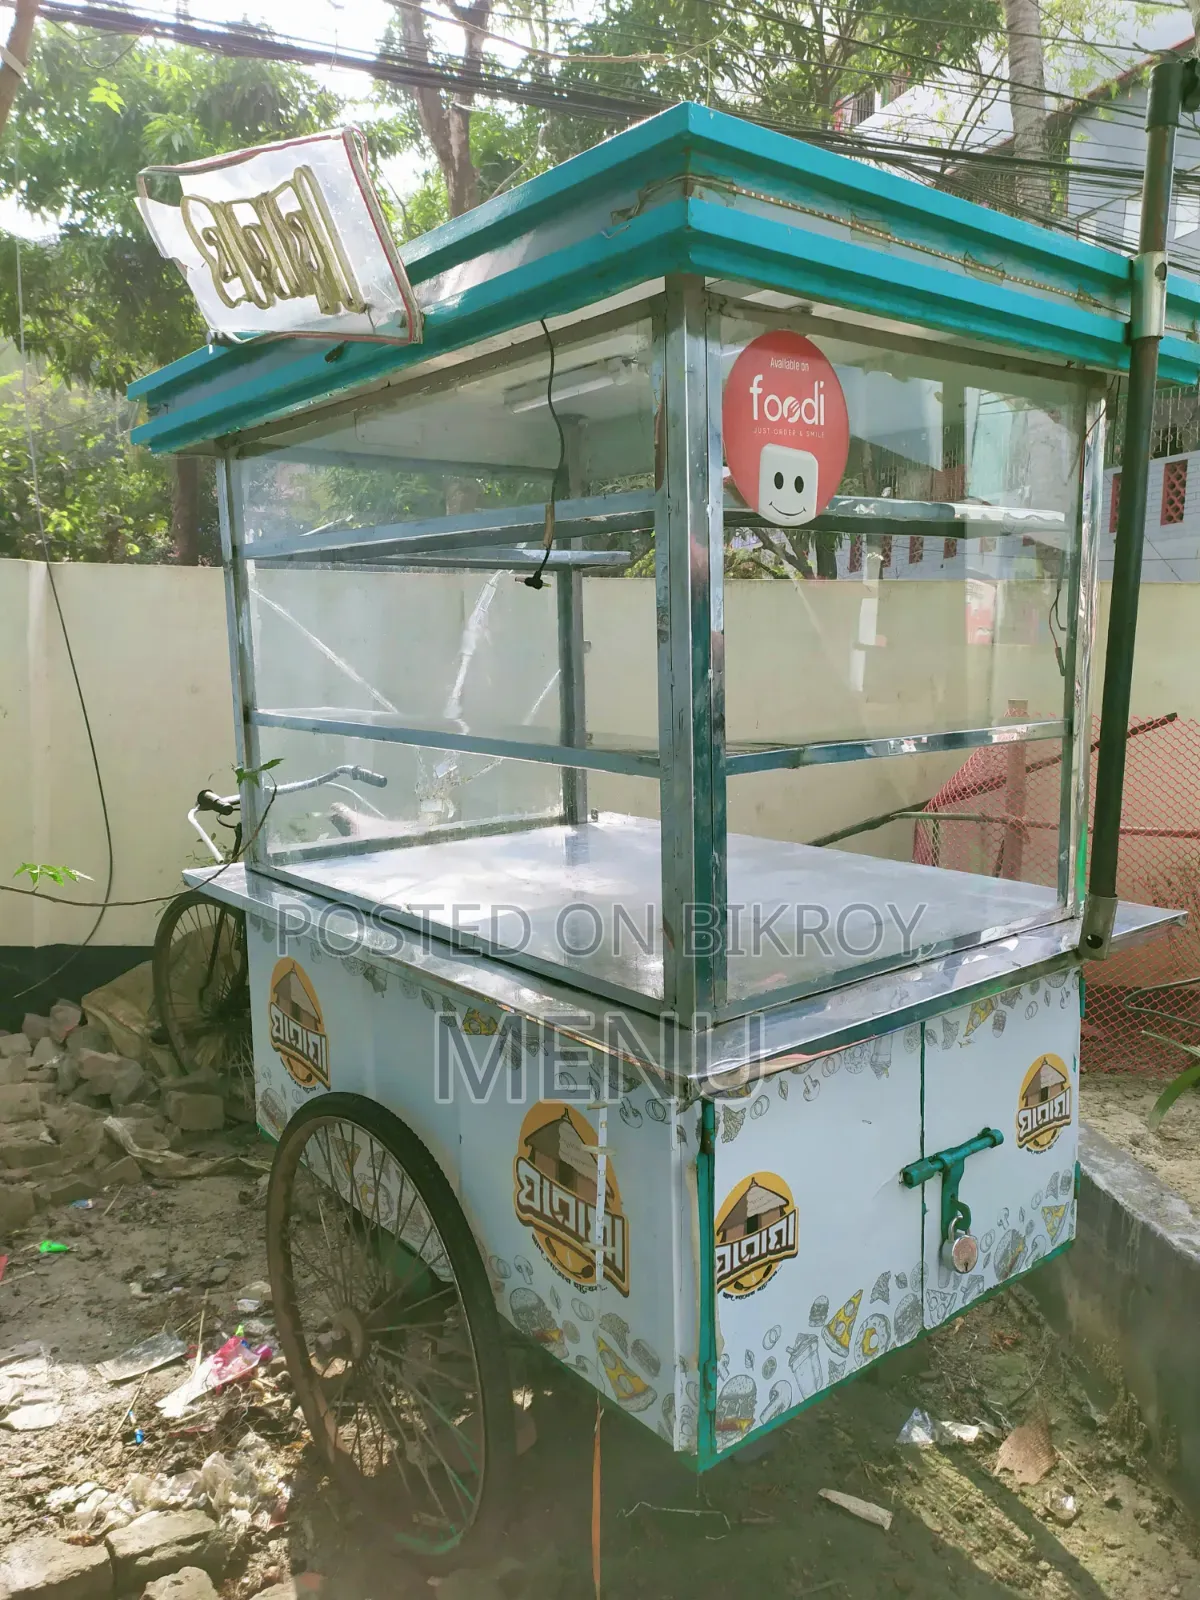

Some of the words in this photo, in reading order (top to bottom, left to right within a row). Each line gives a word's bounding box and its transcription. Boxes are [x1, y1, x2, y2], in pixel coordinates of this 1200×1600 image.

[769, 357, 799, 371] Available
[801, 362, 810, 372] on
[749, 374, 824, 426] foodi
[773, 428, 796, 436] ORDER
[806, 430, 825, 439] SMILE
